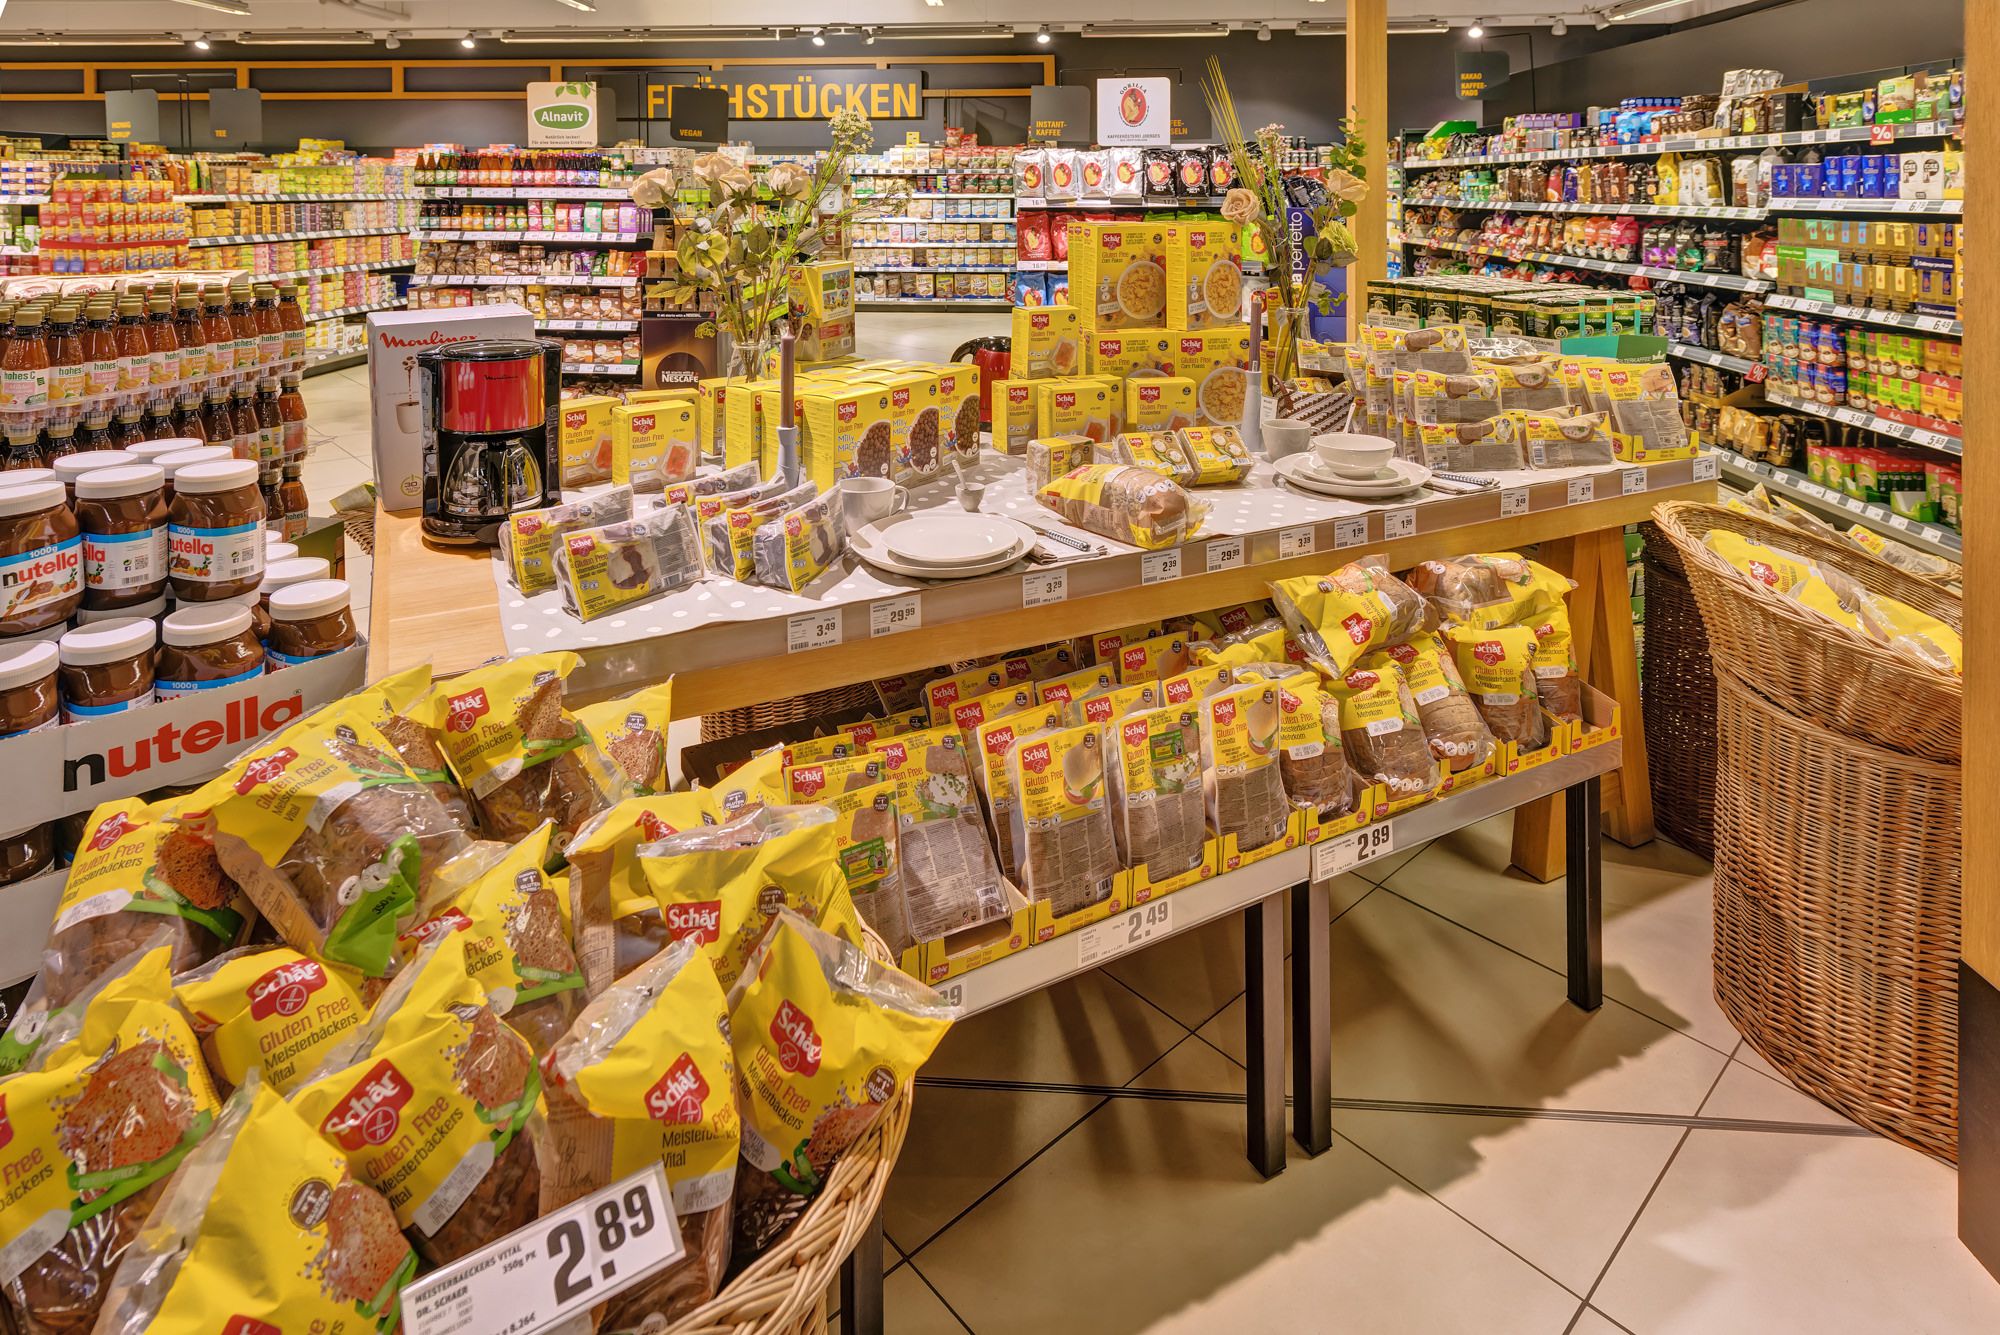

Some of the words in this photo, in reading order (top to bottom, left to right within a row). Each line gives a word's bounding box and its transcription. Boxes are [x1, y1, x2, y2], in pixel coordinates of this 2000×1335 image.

[1120, 83, 1147, 94] GORILLA
[648, 76, 916, 118] FHSTÜCKEN
[541, 111, 583, 122] Alnavit
[679, 129, 702, 137] VEGAN
[1103, 234, 1121, 243] Schär
[1191, 233, 1206, 242] Schär
[1032, 315, 1049, 324] Schär
[1100, 341, 1121, 351] Schär
[1181, 339, 1203, 350] Schär
[4, 372, 28, 380] hohes
[940, 379, 954, 388] Schär
[893, 391, 909, 400] Schär
[1009, 388, 1029, 398] Schär
[1056, 394, 1075, 404] Schär
[1140, 388, 1160, 397] Schär
[839, 404, 856, 414] Schär
[566, 413, 587, 423] Schär
[633, 417, 655, 428] Schär
[632, 435, 651, 443] Gluten
[518, 518, 540, 527] Schär
[1401, 519, 1412, 529] 1.99
[176, 526, 195, 536] 1000g
[570, 539, 593, 548] Schär
[28, 545, 59, 558] 1000g
[1221, 549, 1239, 561] 29.99
[1, 551, 78, 587] nutella
[1162, 560, 1176, 572] 2.39
[1046, 581, 1062, 593] 3.29
[890, 608, 915, 622] 29.99
[816, 622, 835, 636] 3.49
[1100, 639, 1122, 651] Schär
[1124, 651, 1145, 663] Schär
[1006, 661, 1028, 672] Schär
[1500, 667, 1514, 675] Free
[171, 681, 198, 690] 1000g
[1167, 683, 1192, 697] Schär
[932, 687, 957, 700] Schär
[1044, 688, 1070, 700] Schär
[1085, 702, 1110, 715] Schär
[1214, 701, 1234, 713] Schär
[1357, 709, 1384, 718] Mehrkorn
[956, 707, 982, 721] Schär
[482, 720, 505, 738] Free
[1124, 724, 1147, 736] Schär
[1216, 727, 1235, 738] Gluten
[1236, 723, 1247, 733] Free
[63, 694, 303, 793] nutella
[986, 731, 1013, 746] Schär
[1216, 736, 1236, 746] Ciabatta
[1023, 748, 1048, 761] Schär
[793, 772, 822, 784] Schär
[906, 767, 923, 777] Free
[1128, 767, 1145, 776] Rustica
[256, 776, 295, 809] Gluten
[296, 758, 326, 777] Free
[1024, 775, 1048, 787] Gluten
[1050, 771, 1063, 782] Free
[1026, 786, 1048, 796] Ciabatta
[284, 804, 301, 822] Vital
[1358, 825, 1389, 861] 2.89
[114, 842, 145, 859] Free
[668, 906, 721, 929] Schär
[1127, 900, 1169, 944] 2.49
[465, 936, 495, 959] Free
[253, 961, 320, 1001] Schär
[259, 1015, 312, 1054] Gluten
[316, 997, 350, 1023] Free
[777, 1007, 821, 1062] Schär
[264, 1012, 359, 1071] Meisterbäckers
[267, 1065, 296, 1087] Vital
[756, 1048, 782, 1094] Gluten
[784, 1086, 810, 1113] Free
[650, 1065, 700, 1118] Schär
[746, 1061, 804, 1130] Meisterbäckers
[326, 1070, 400, 1135] Schär
[365, 1134, 414, 1181] Gluten
[412, 1096, 450, 1137] Free
[376, 1108, 464, 1196] Meisterbäckers
[662, 1150, 686, 1168] Vital
[1, 1146, 44, 1187] Free
[546, 1184, 655, 1306] 2.89
[502, 1259, 524, 1274] 350g
[526, 1250, 536, 1262] PK
[415, 1257, 496, 1304] MEISTERBAECKERS
[498, 1245, 522, 1262] VITAL
[416, 1305, 431, 1319] DR.
[434, 1286, 469, 1310] SCHAER
[510, 1312, 536, 1333] 8.26€
